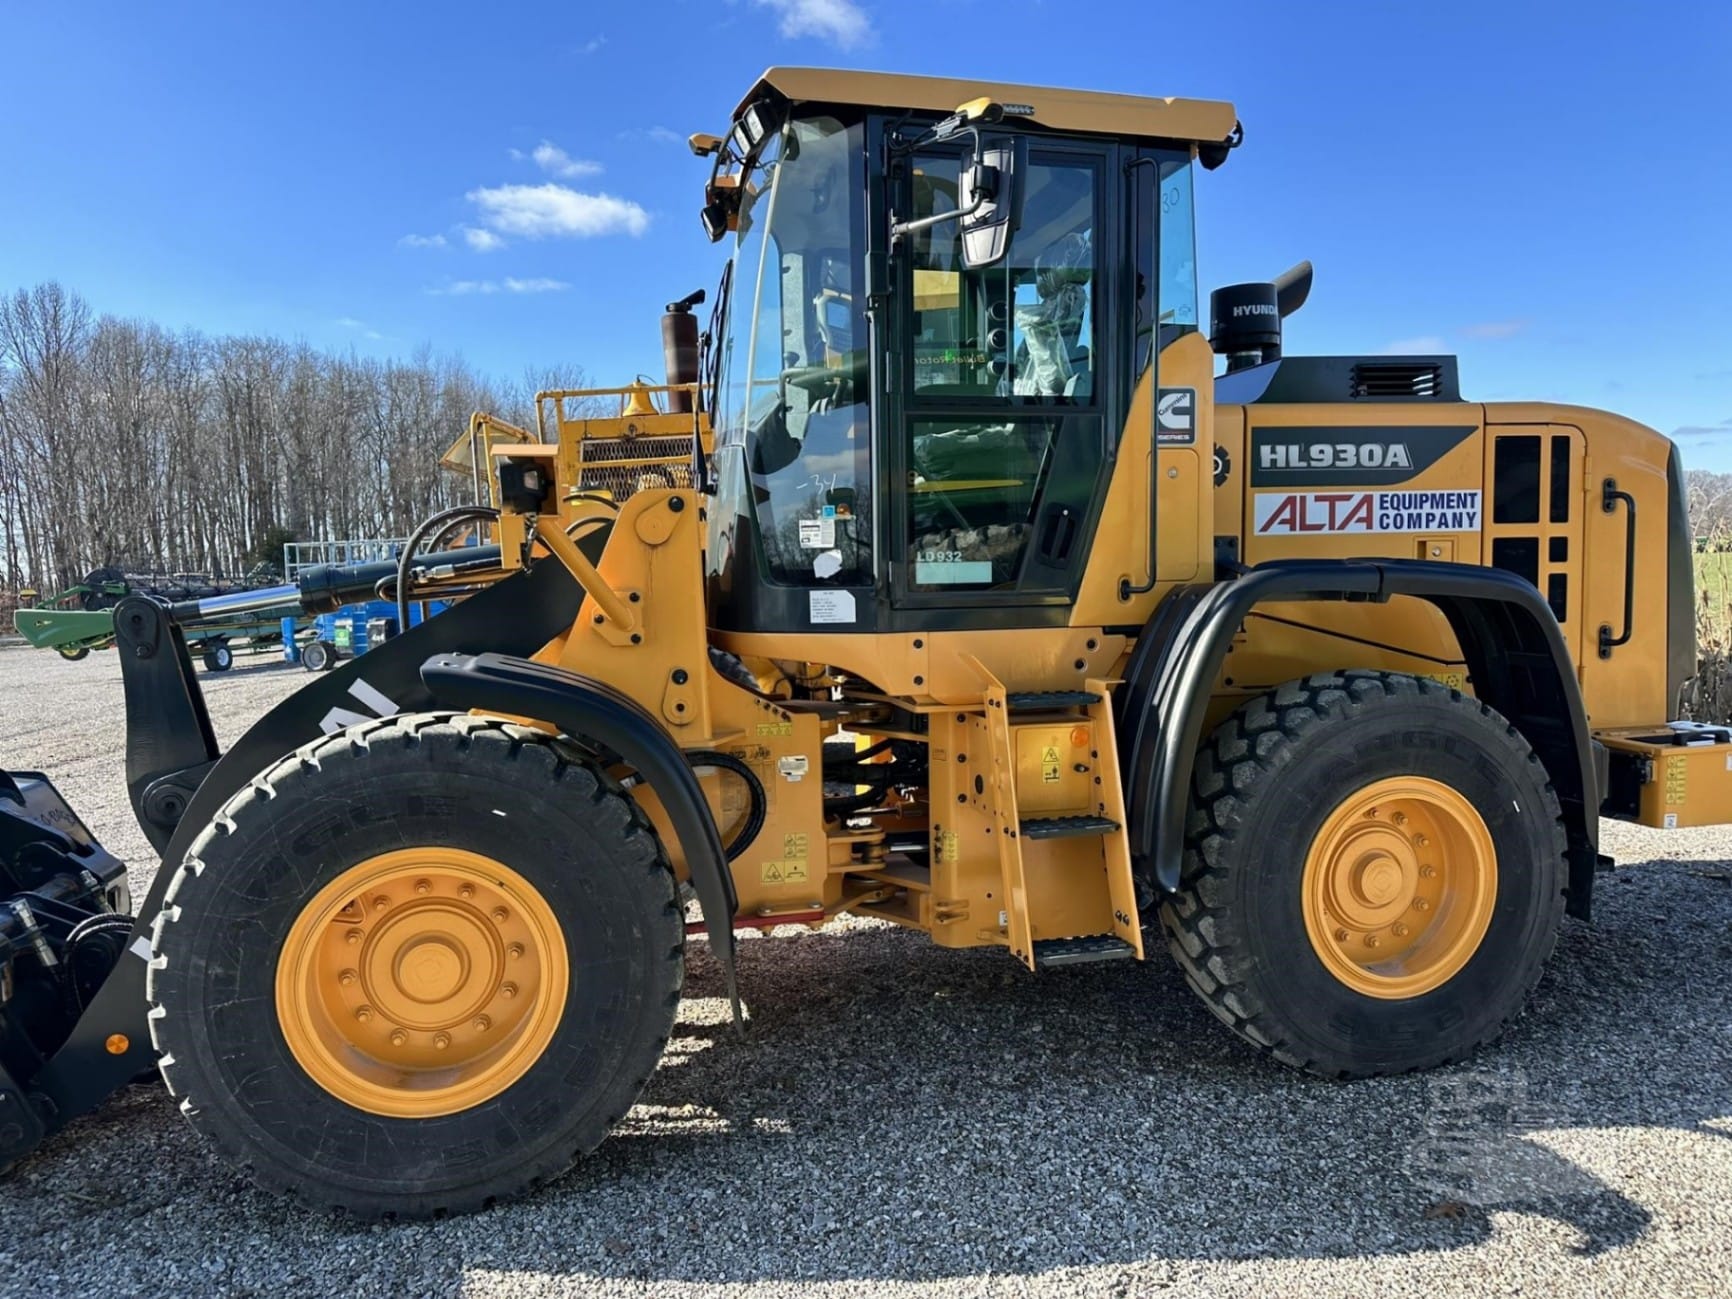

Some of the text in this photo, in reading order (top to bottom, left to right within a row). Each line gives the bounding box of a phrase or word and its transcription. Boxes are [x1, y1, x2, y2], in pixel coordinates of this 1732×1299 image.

[1260, 443, 1412, 468] HL930A
[1379, 492, 1478, 511] EQUIPMENT
[1258, 494, 1374, 532] ALTA
[1379, 511, 1477, 530] COMPANY
